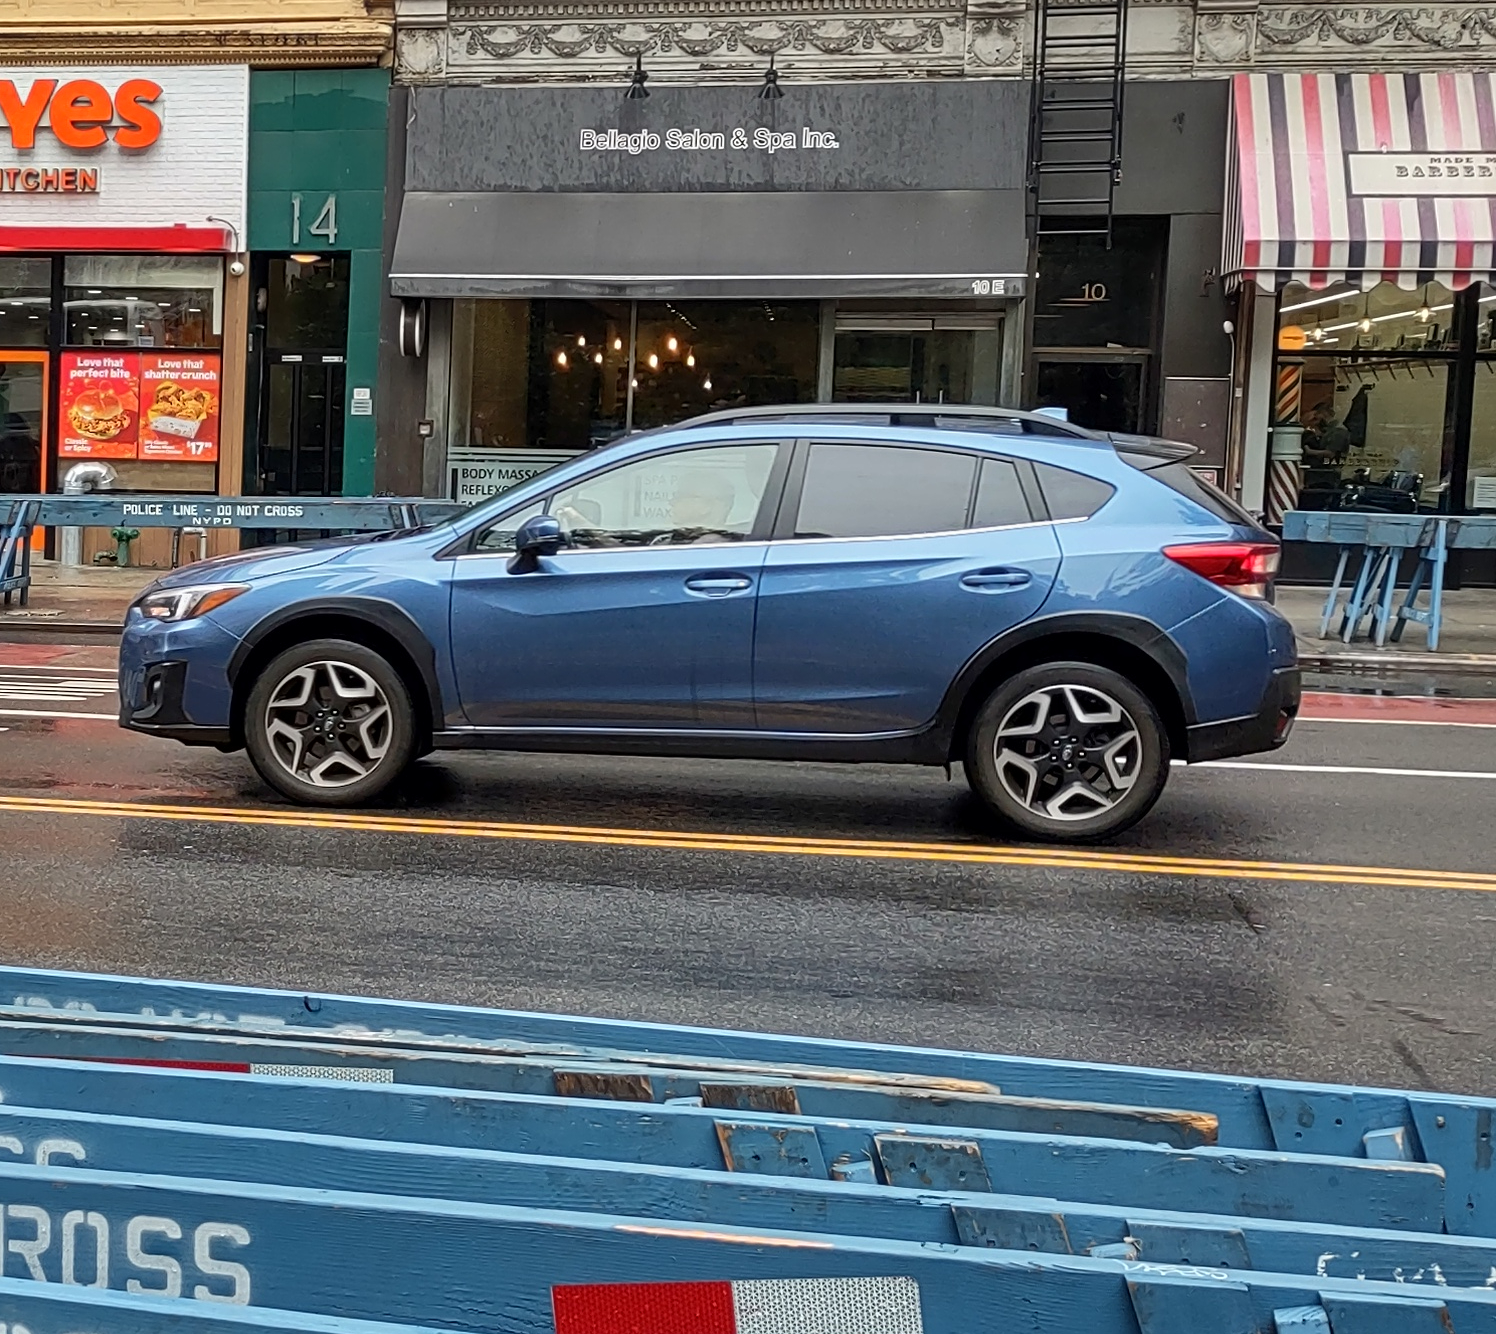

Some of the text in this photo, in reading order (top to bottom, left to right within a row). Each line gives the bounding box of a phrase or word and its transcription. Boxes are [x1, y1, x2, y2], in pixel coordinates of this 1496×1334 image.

[580, 127, 840, 155] Bellagio Salon & Spa Inc.
[1395, 165, 1496, 178] BARBER
[292, 193, 338, 245] 14
[971, 280, 1005, 295] 10 E
[1080, 283, 1106, 300] 10
[77, 357, 124, 367] Love that
[158, 358, 204, 369] Love that
[70, 368, 131, 379] perfect bite
[144, 370, 217, 380] shatter crunch
[462, 468, 494, 479] BODY
[123, 504, 164, 515] POLICE
[173, 504, 198, 516] LINE
[217, 505, 232, 516] DO
[237, 505, 260, 516] NOT
[264, 505, 303, 517] CROSS
[192, 517, 232, 525] NYPD
